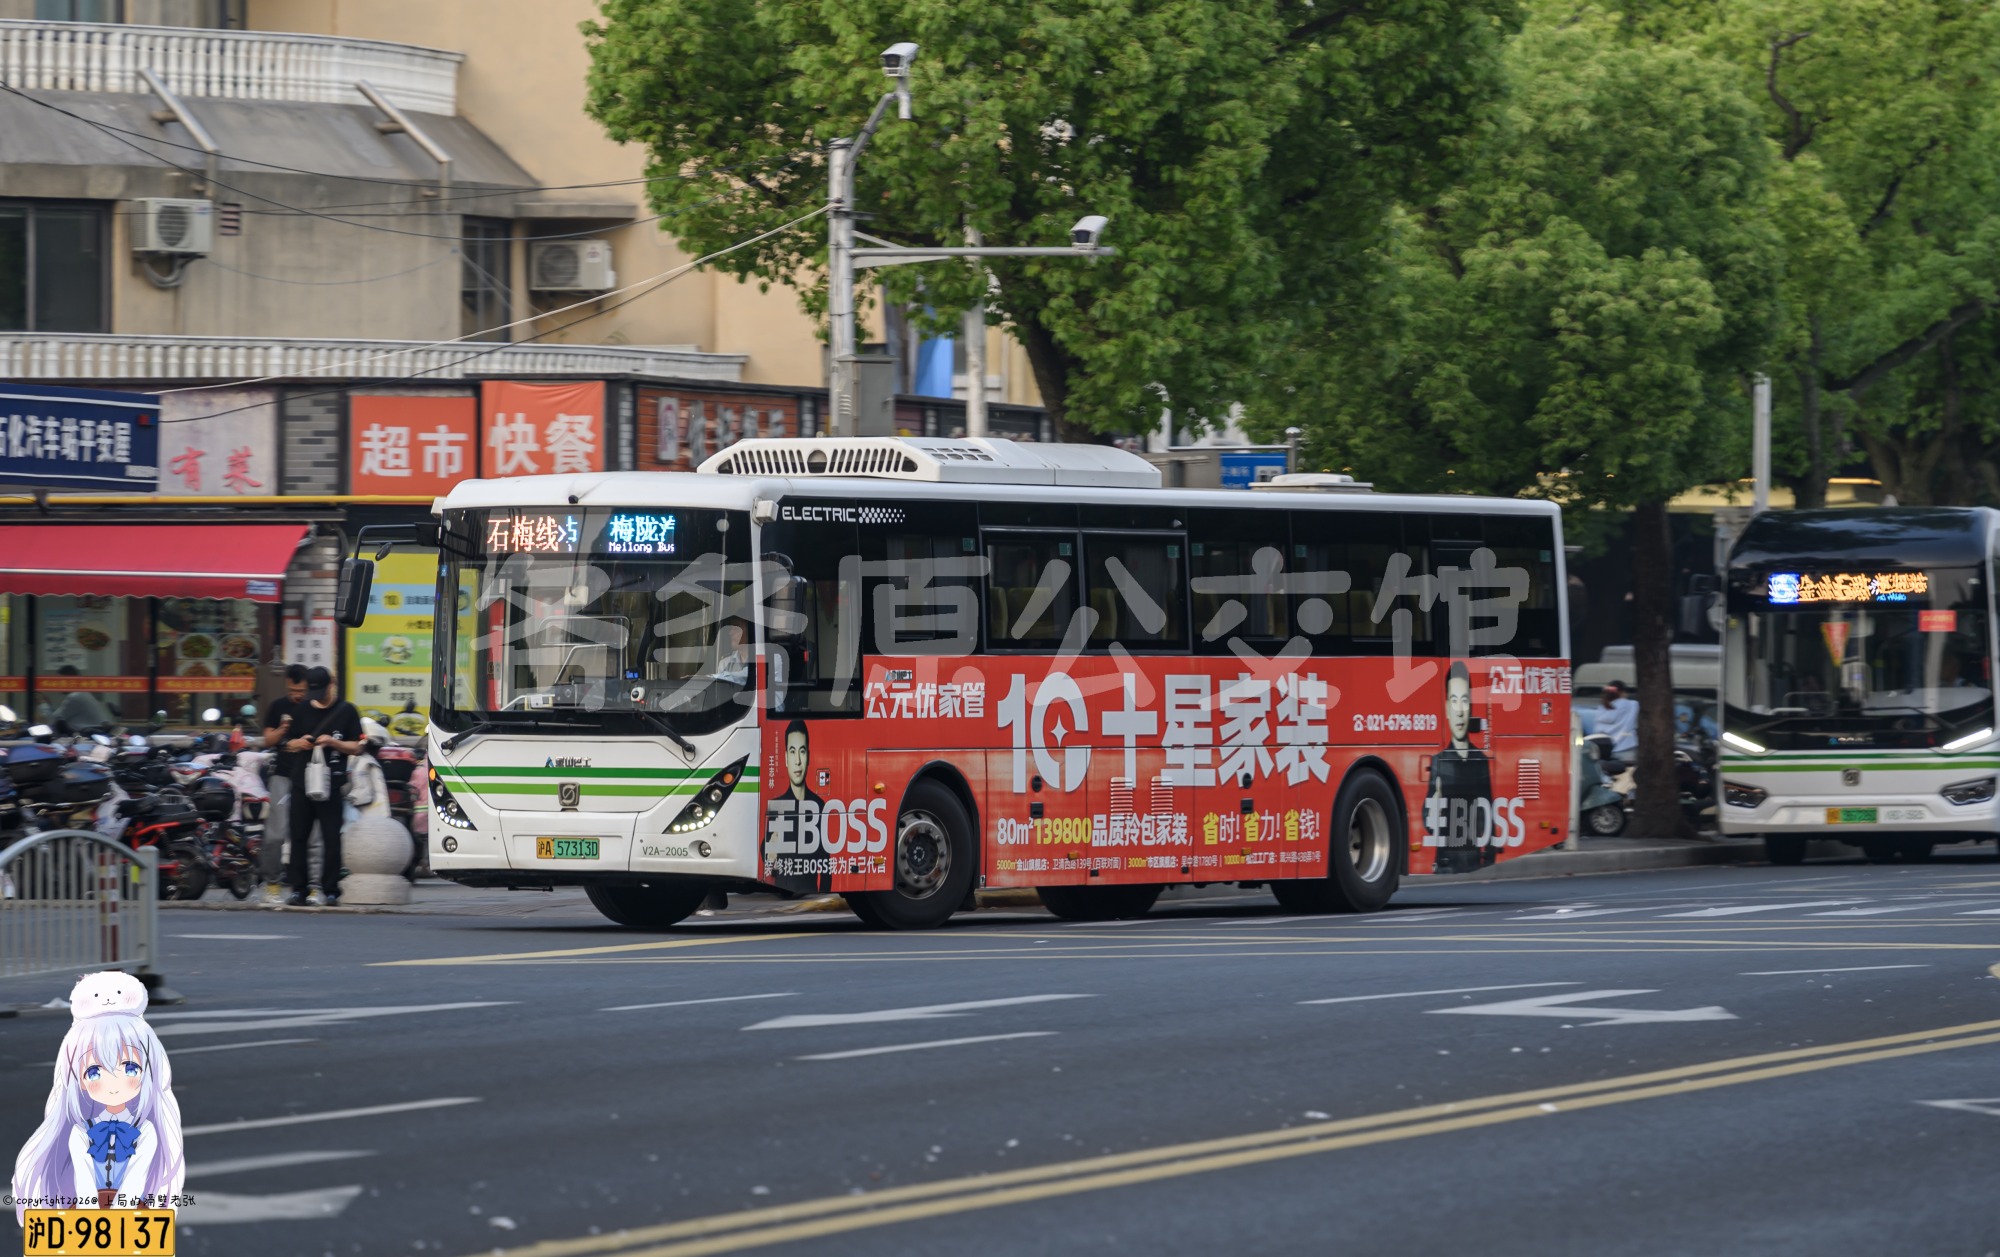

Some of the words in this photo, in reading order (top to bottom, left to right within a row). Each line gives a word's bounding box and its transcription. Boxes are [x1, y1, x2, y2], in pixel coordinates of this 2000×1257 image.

[360, 423, 469, 479] 超市
[489, 412, 597, 475] 快餐
[782, 506, 857, 522] ELECTRIC
[487, 515, 559, 552] 石梅线
[609, 542, 653, 553] Meilong
[865, 682, 985, 718] 公元优家管
[765, 798, 888, 854] 王BOSS
[642, 846, 689, 856] V2A-2005
